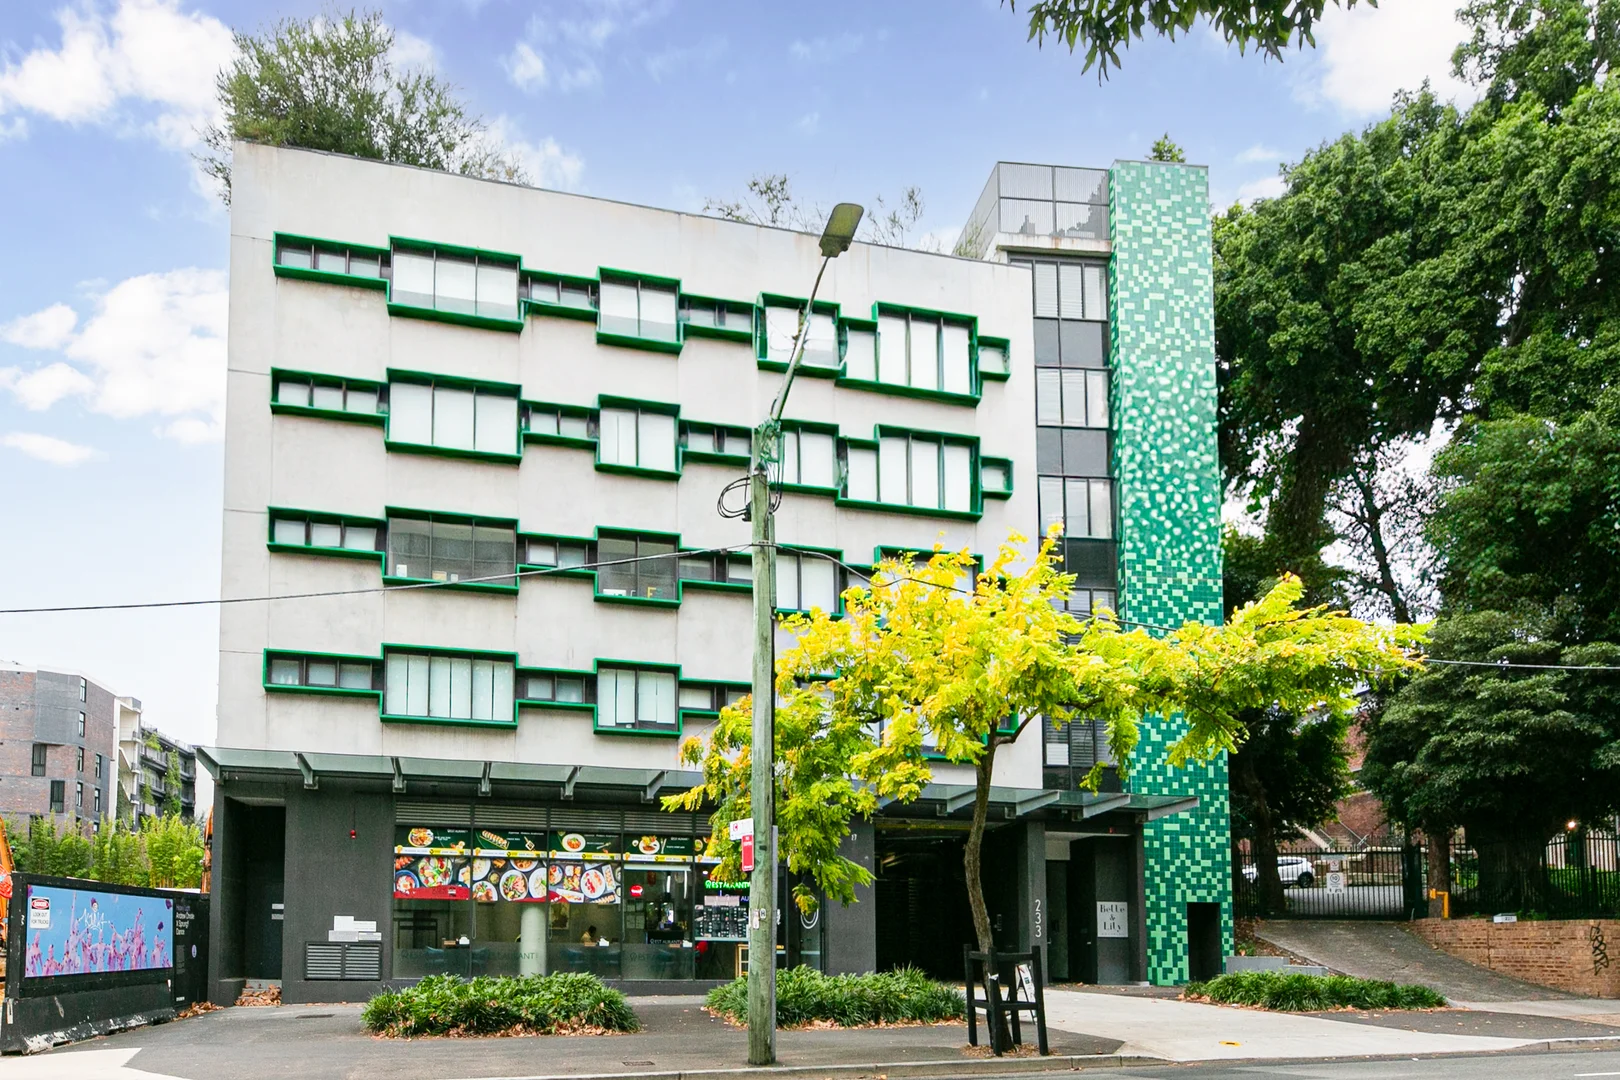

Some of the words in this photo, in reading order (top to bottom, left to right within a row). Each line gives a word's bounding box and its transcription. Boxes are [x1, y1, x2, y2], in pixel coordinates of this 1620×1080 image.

[1100, 904, 1125, 913] Belle
[1034, 899, 1042, 938] 233
[1103, 921, 1121, 932] Lily
